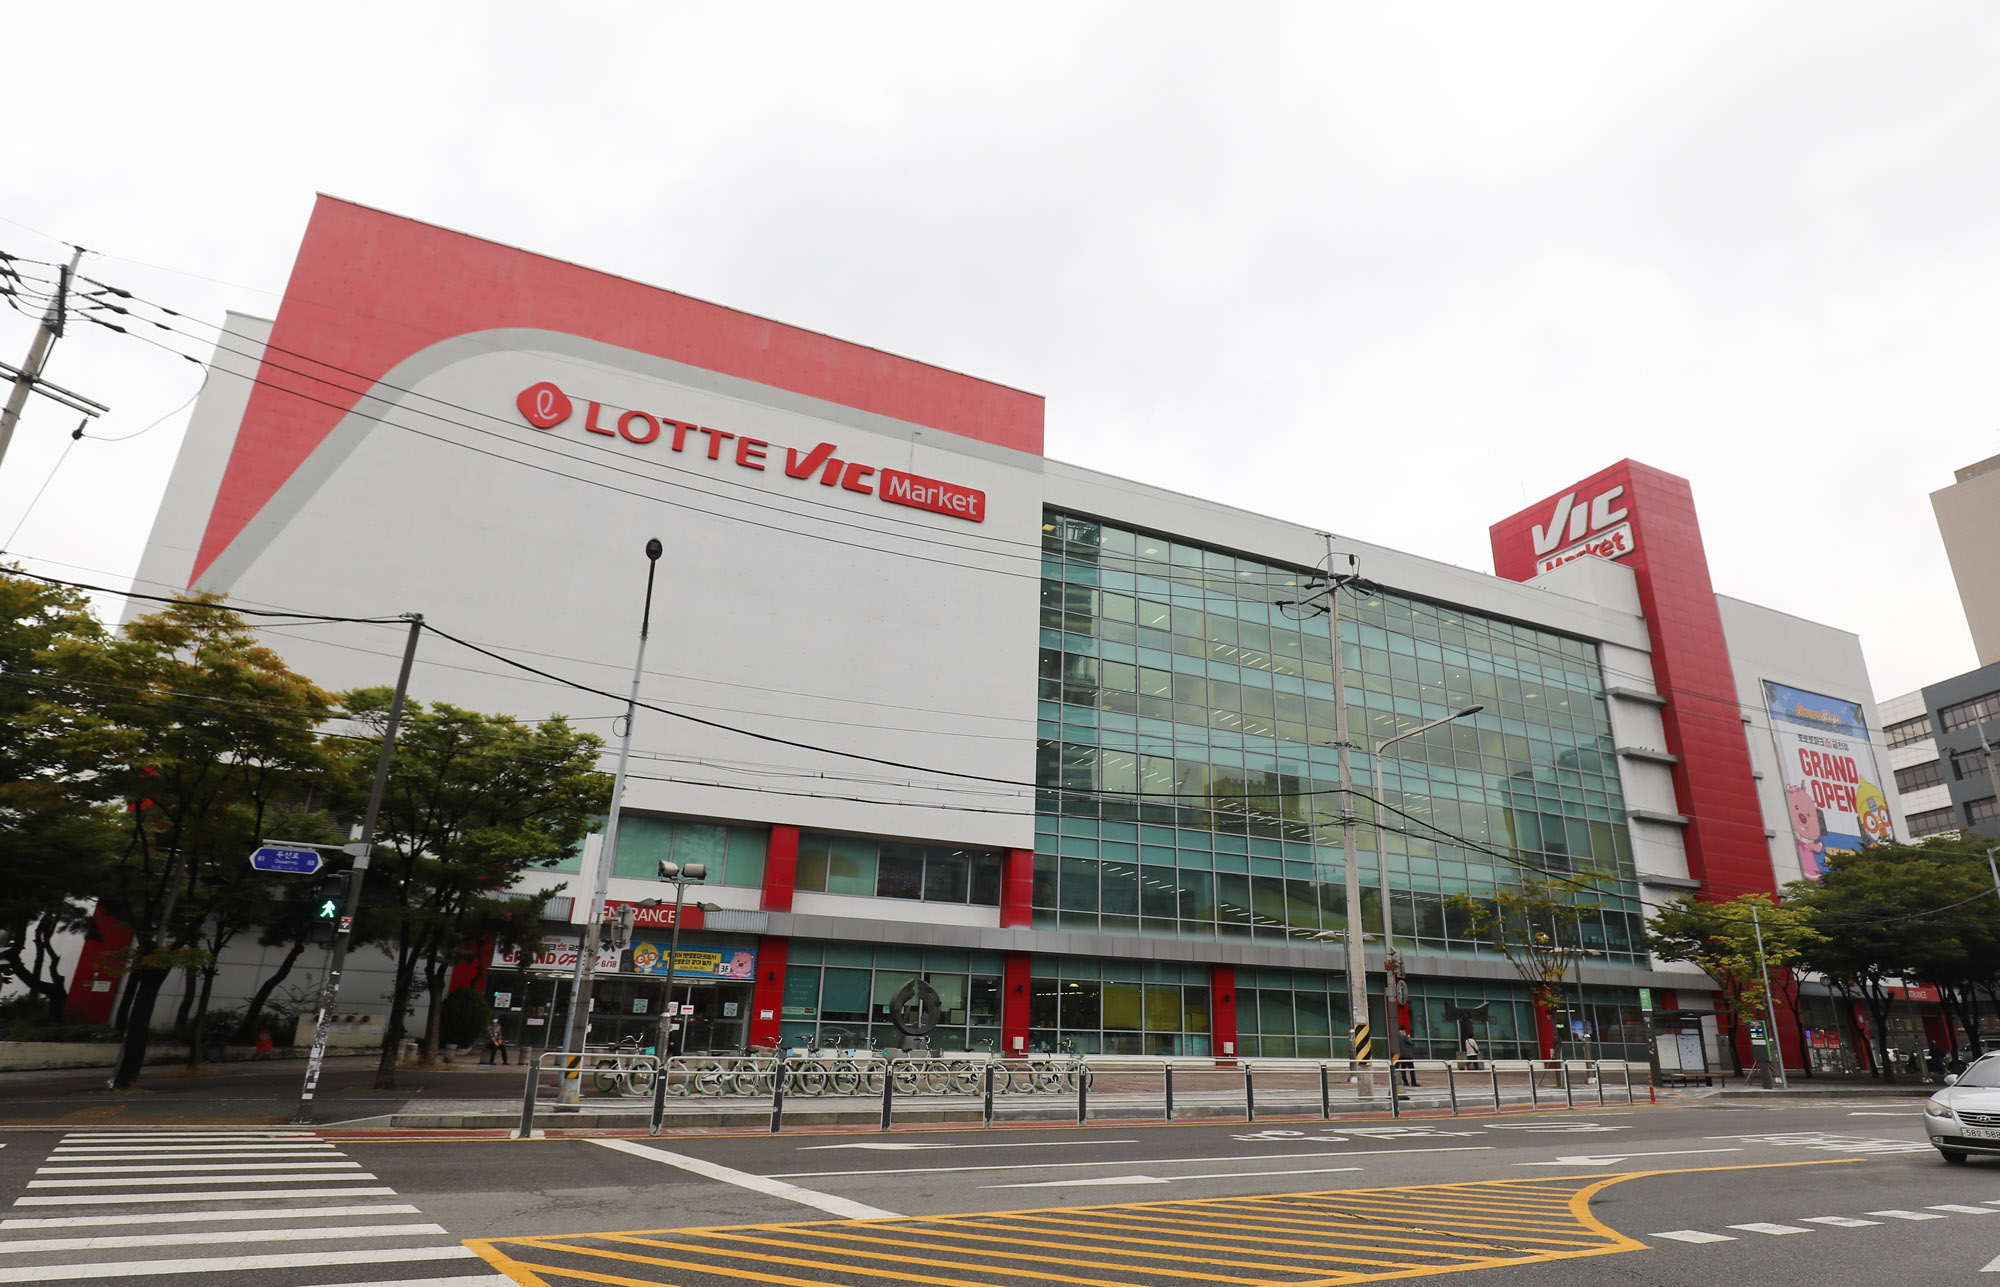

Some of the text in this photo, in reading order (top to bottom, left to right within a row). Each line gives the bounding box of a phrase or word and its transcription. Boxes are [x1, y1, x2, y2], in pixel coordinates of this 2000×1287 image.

[584, 400, 769, 471] LOTTE
[887, 475, 978, 515] Market
[1798, 748, 1859, 784] GRAND
[1811, 779, 1859, 814] OPEN
[603, 906, 677, 923] ENRANCE
[601, 960, 617, 968] 6/18
